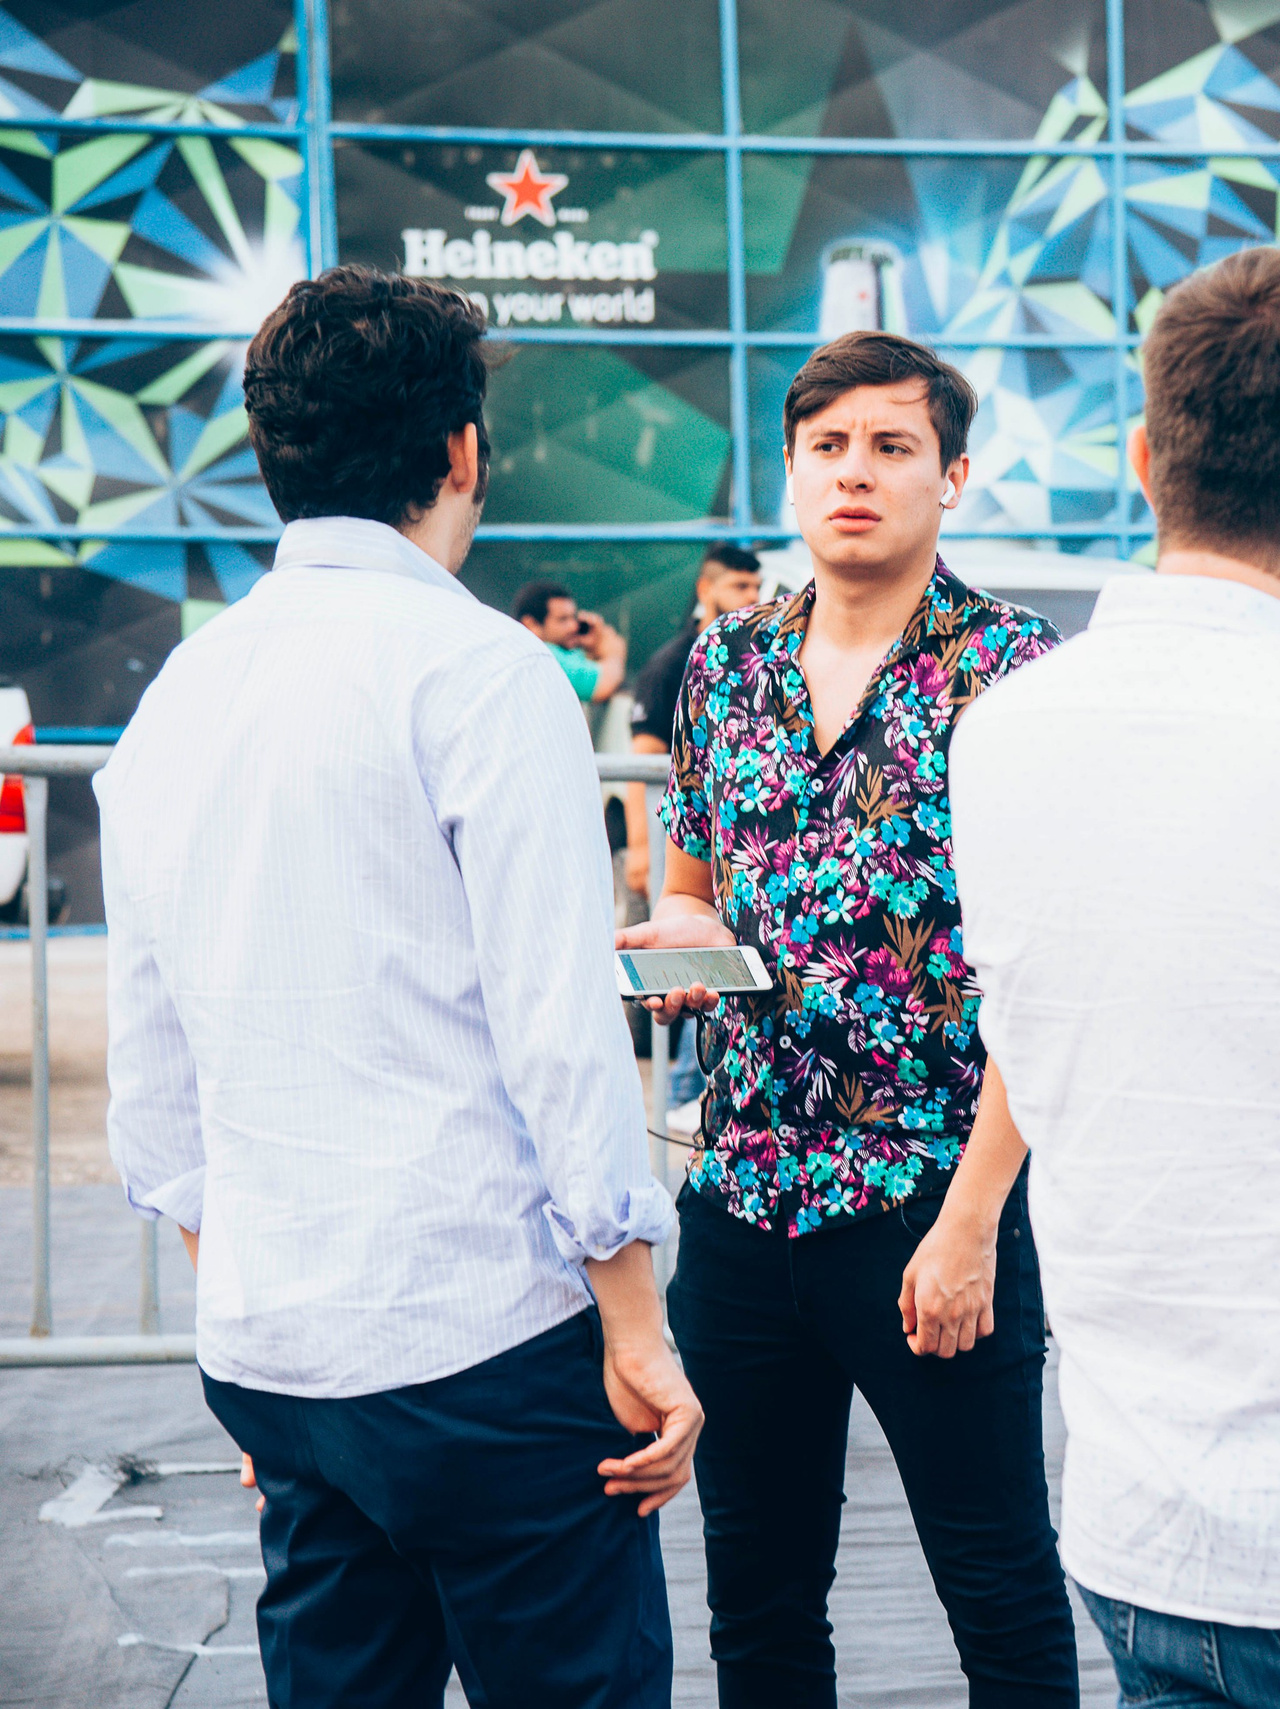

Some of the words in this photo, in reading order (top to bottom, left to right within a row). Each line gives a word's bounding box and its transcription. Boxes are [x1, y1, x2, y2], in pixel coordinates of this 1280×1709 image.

[402, 229, 658, 280] Heineken
[493, 292, 563, 326] your
[567, 286, 656, 323] world
